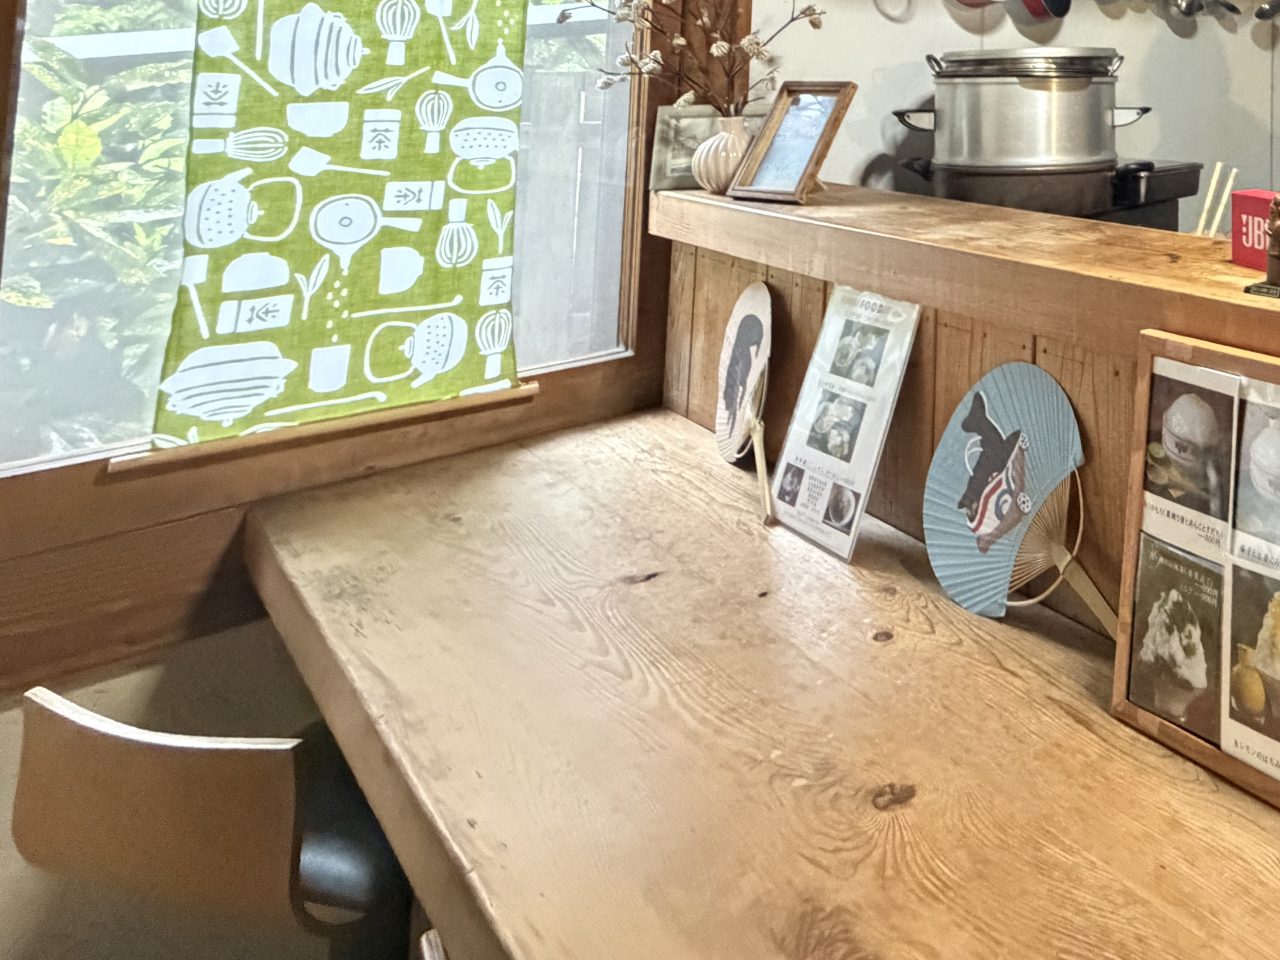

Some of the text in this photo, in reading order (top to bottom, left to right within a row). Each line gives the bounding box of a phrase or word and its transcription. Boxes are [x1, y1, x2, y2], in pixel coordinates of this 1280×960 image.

[369, 127, 396, 151] 茶
[394, 186, 424, 205] 茶
[487, 274, 508, 297] 茶
[246, 303, 282, 325] 茶
